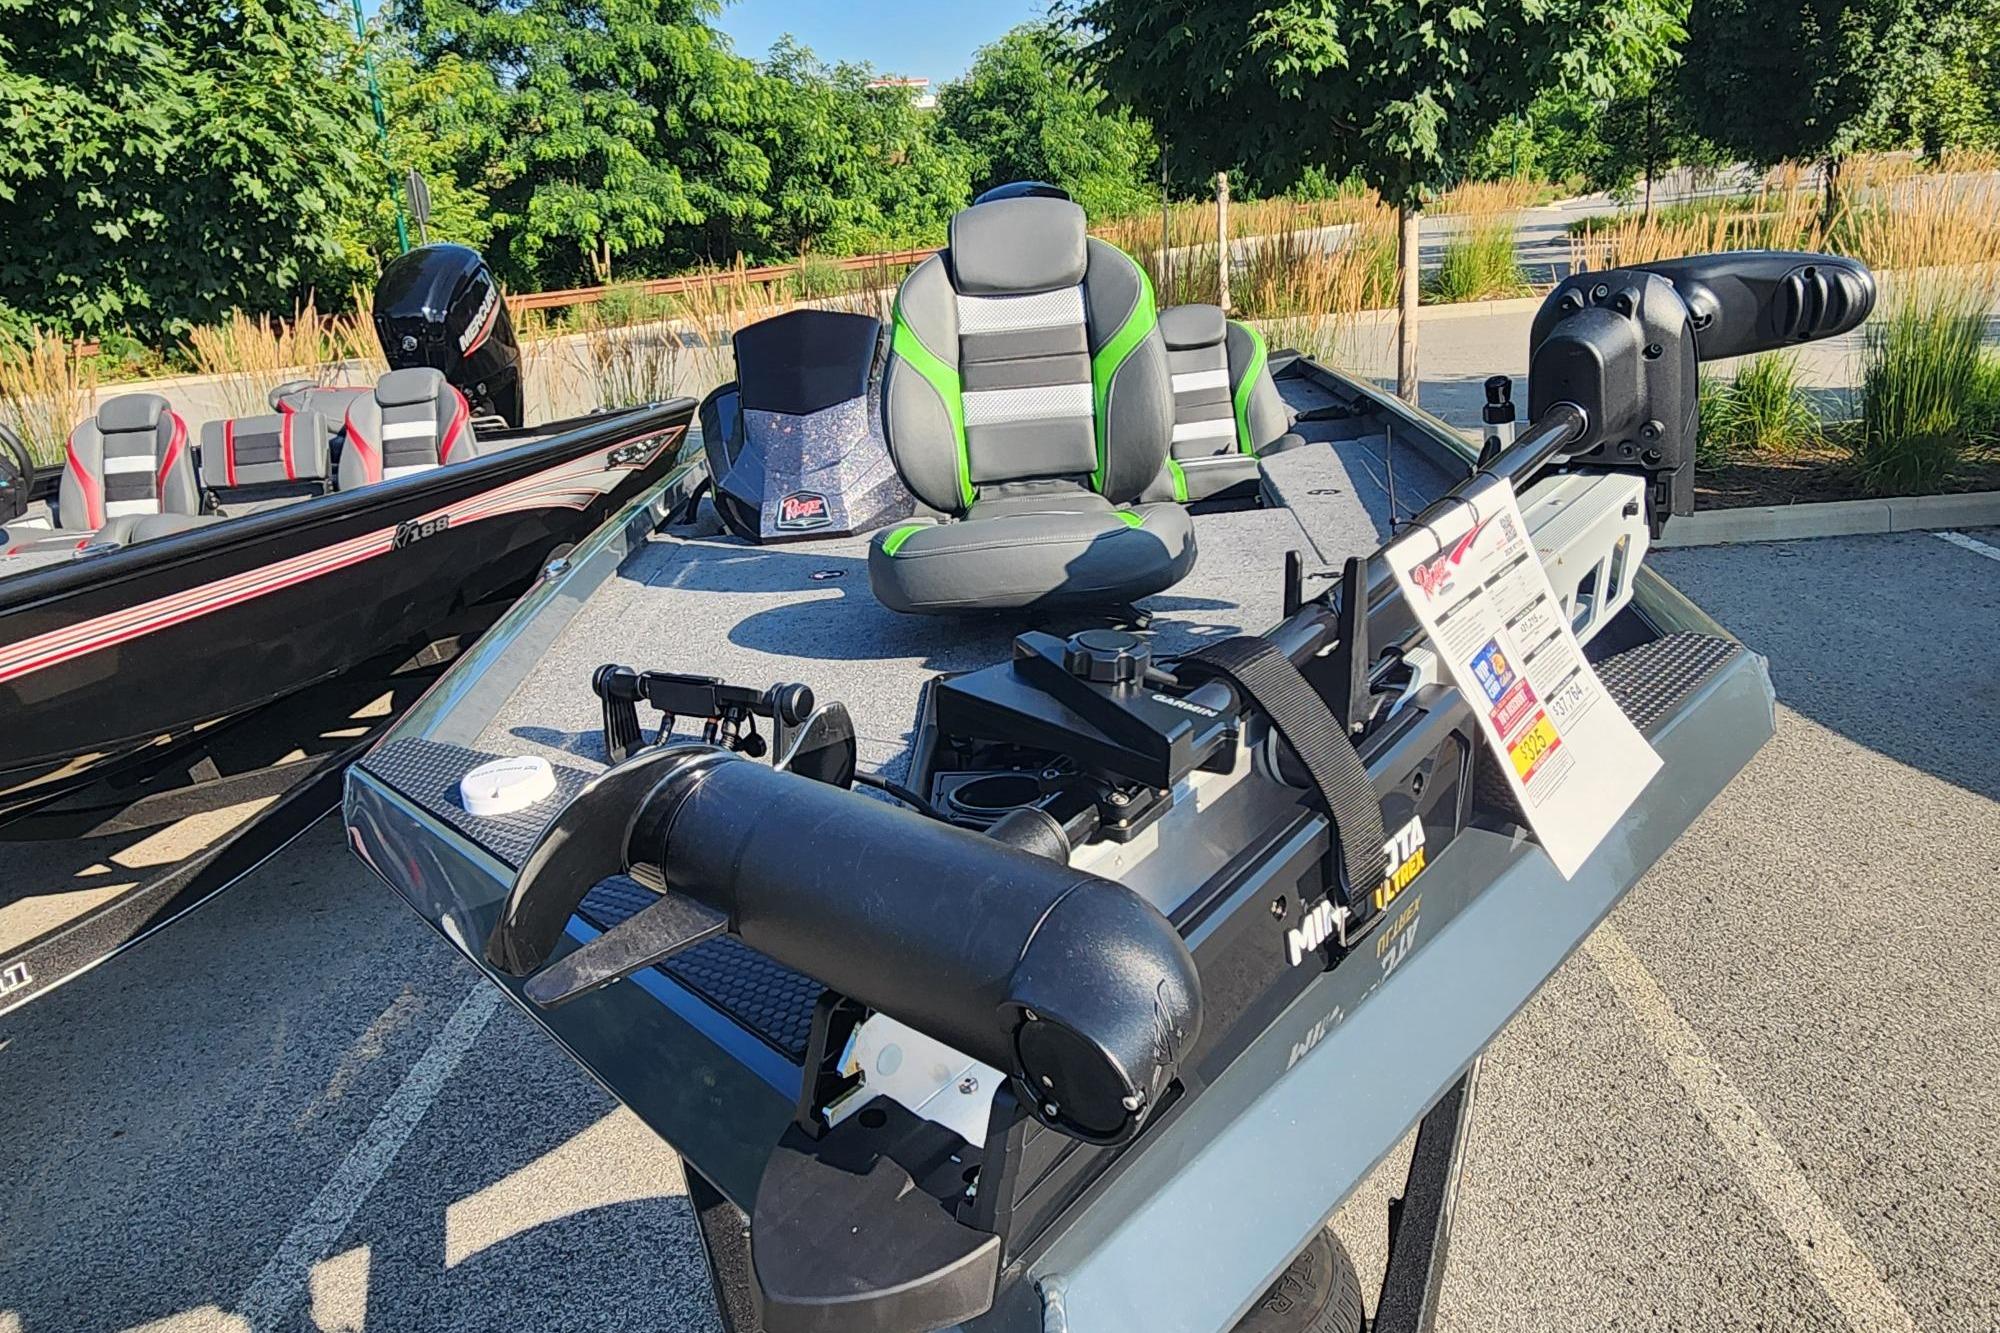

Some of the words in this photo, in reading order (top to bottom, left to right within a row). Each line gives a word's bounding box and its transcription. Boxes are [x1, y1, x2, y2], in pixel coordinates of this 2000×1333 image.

[1151, 694, 1219, 718] GARMIN
[1552, 681, 1583, 717] $37,764
[1520, 728, 1547, 761] $325
